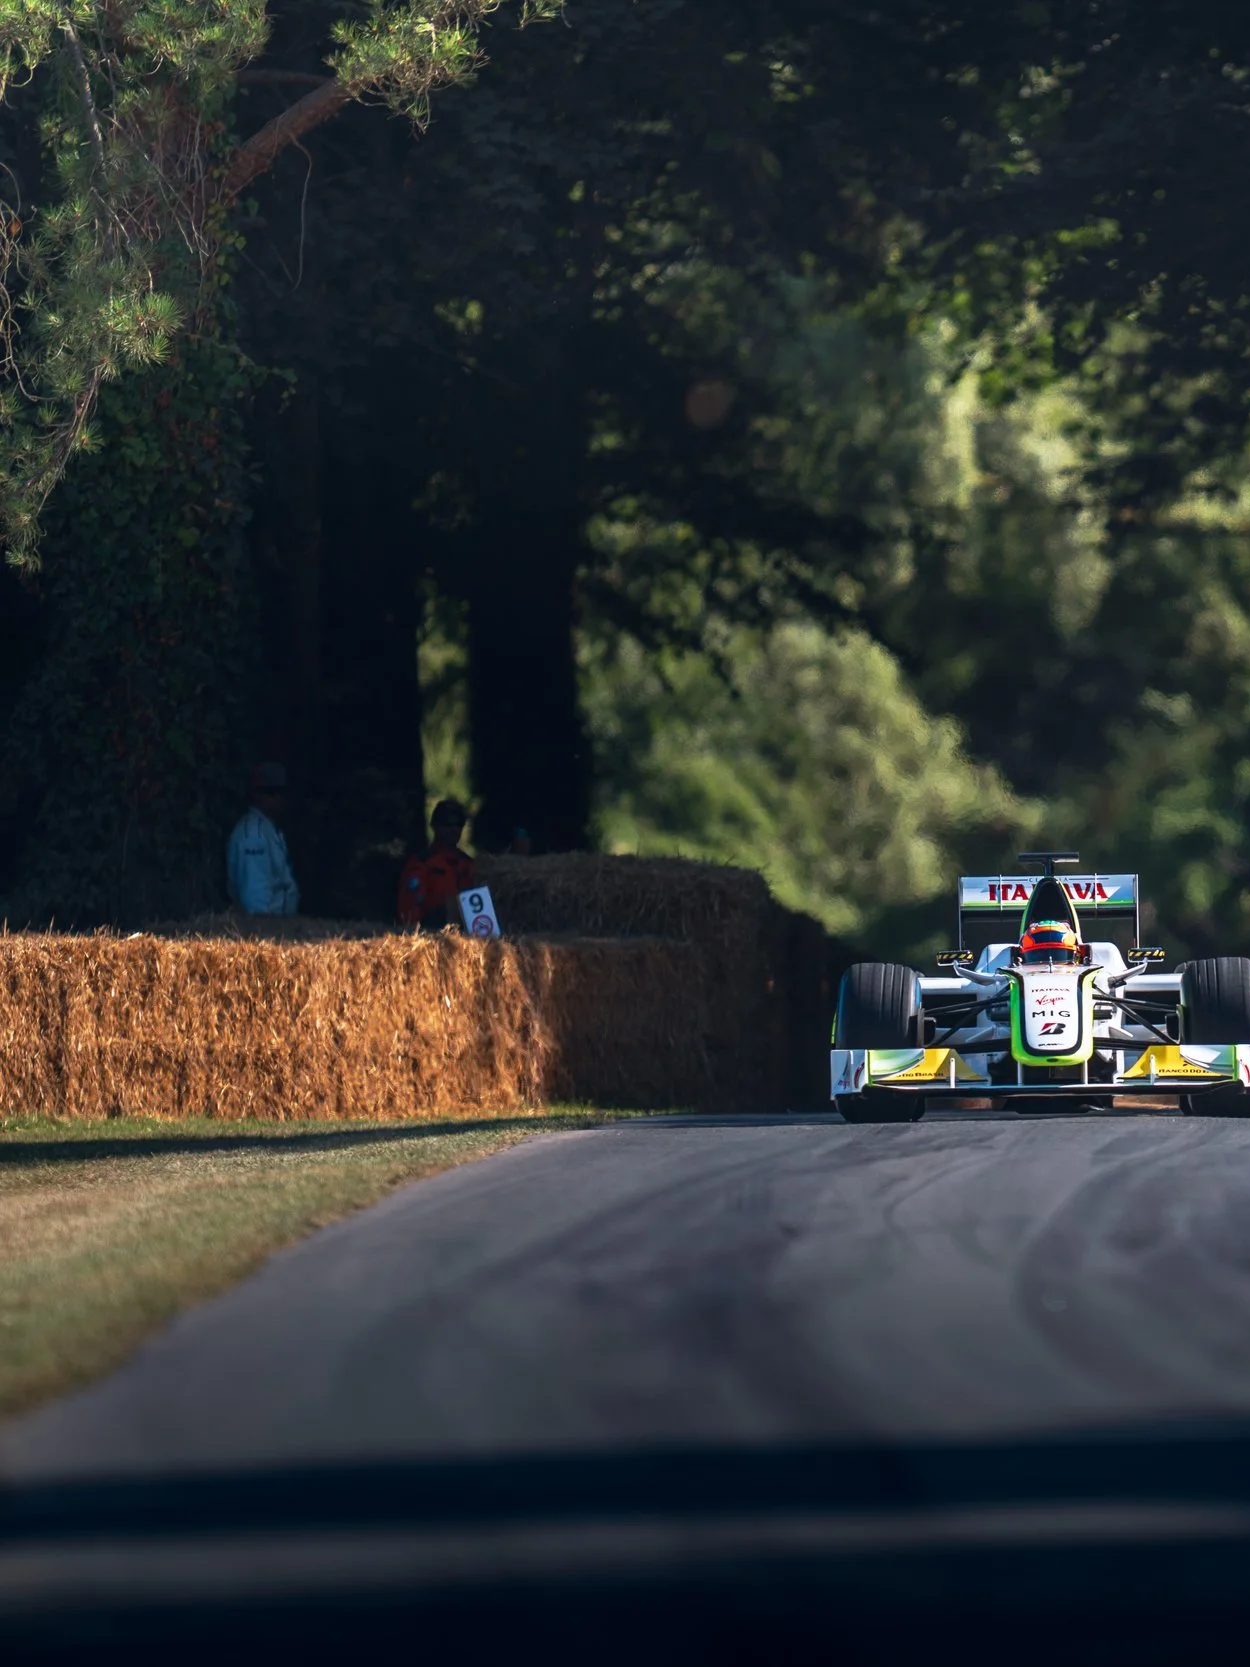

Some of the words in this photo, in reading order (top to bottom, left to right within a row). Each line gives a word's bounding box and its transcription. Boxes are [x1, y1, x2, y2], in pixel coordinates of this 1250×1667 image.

[989, 883, 1108, 901] ITAAVA
[469, 893, 484, 914] 9
[1032, 1010, 1071, 1018] MIG
